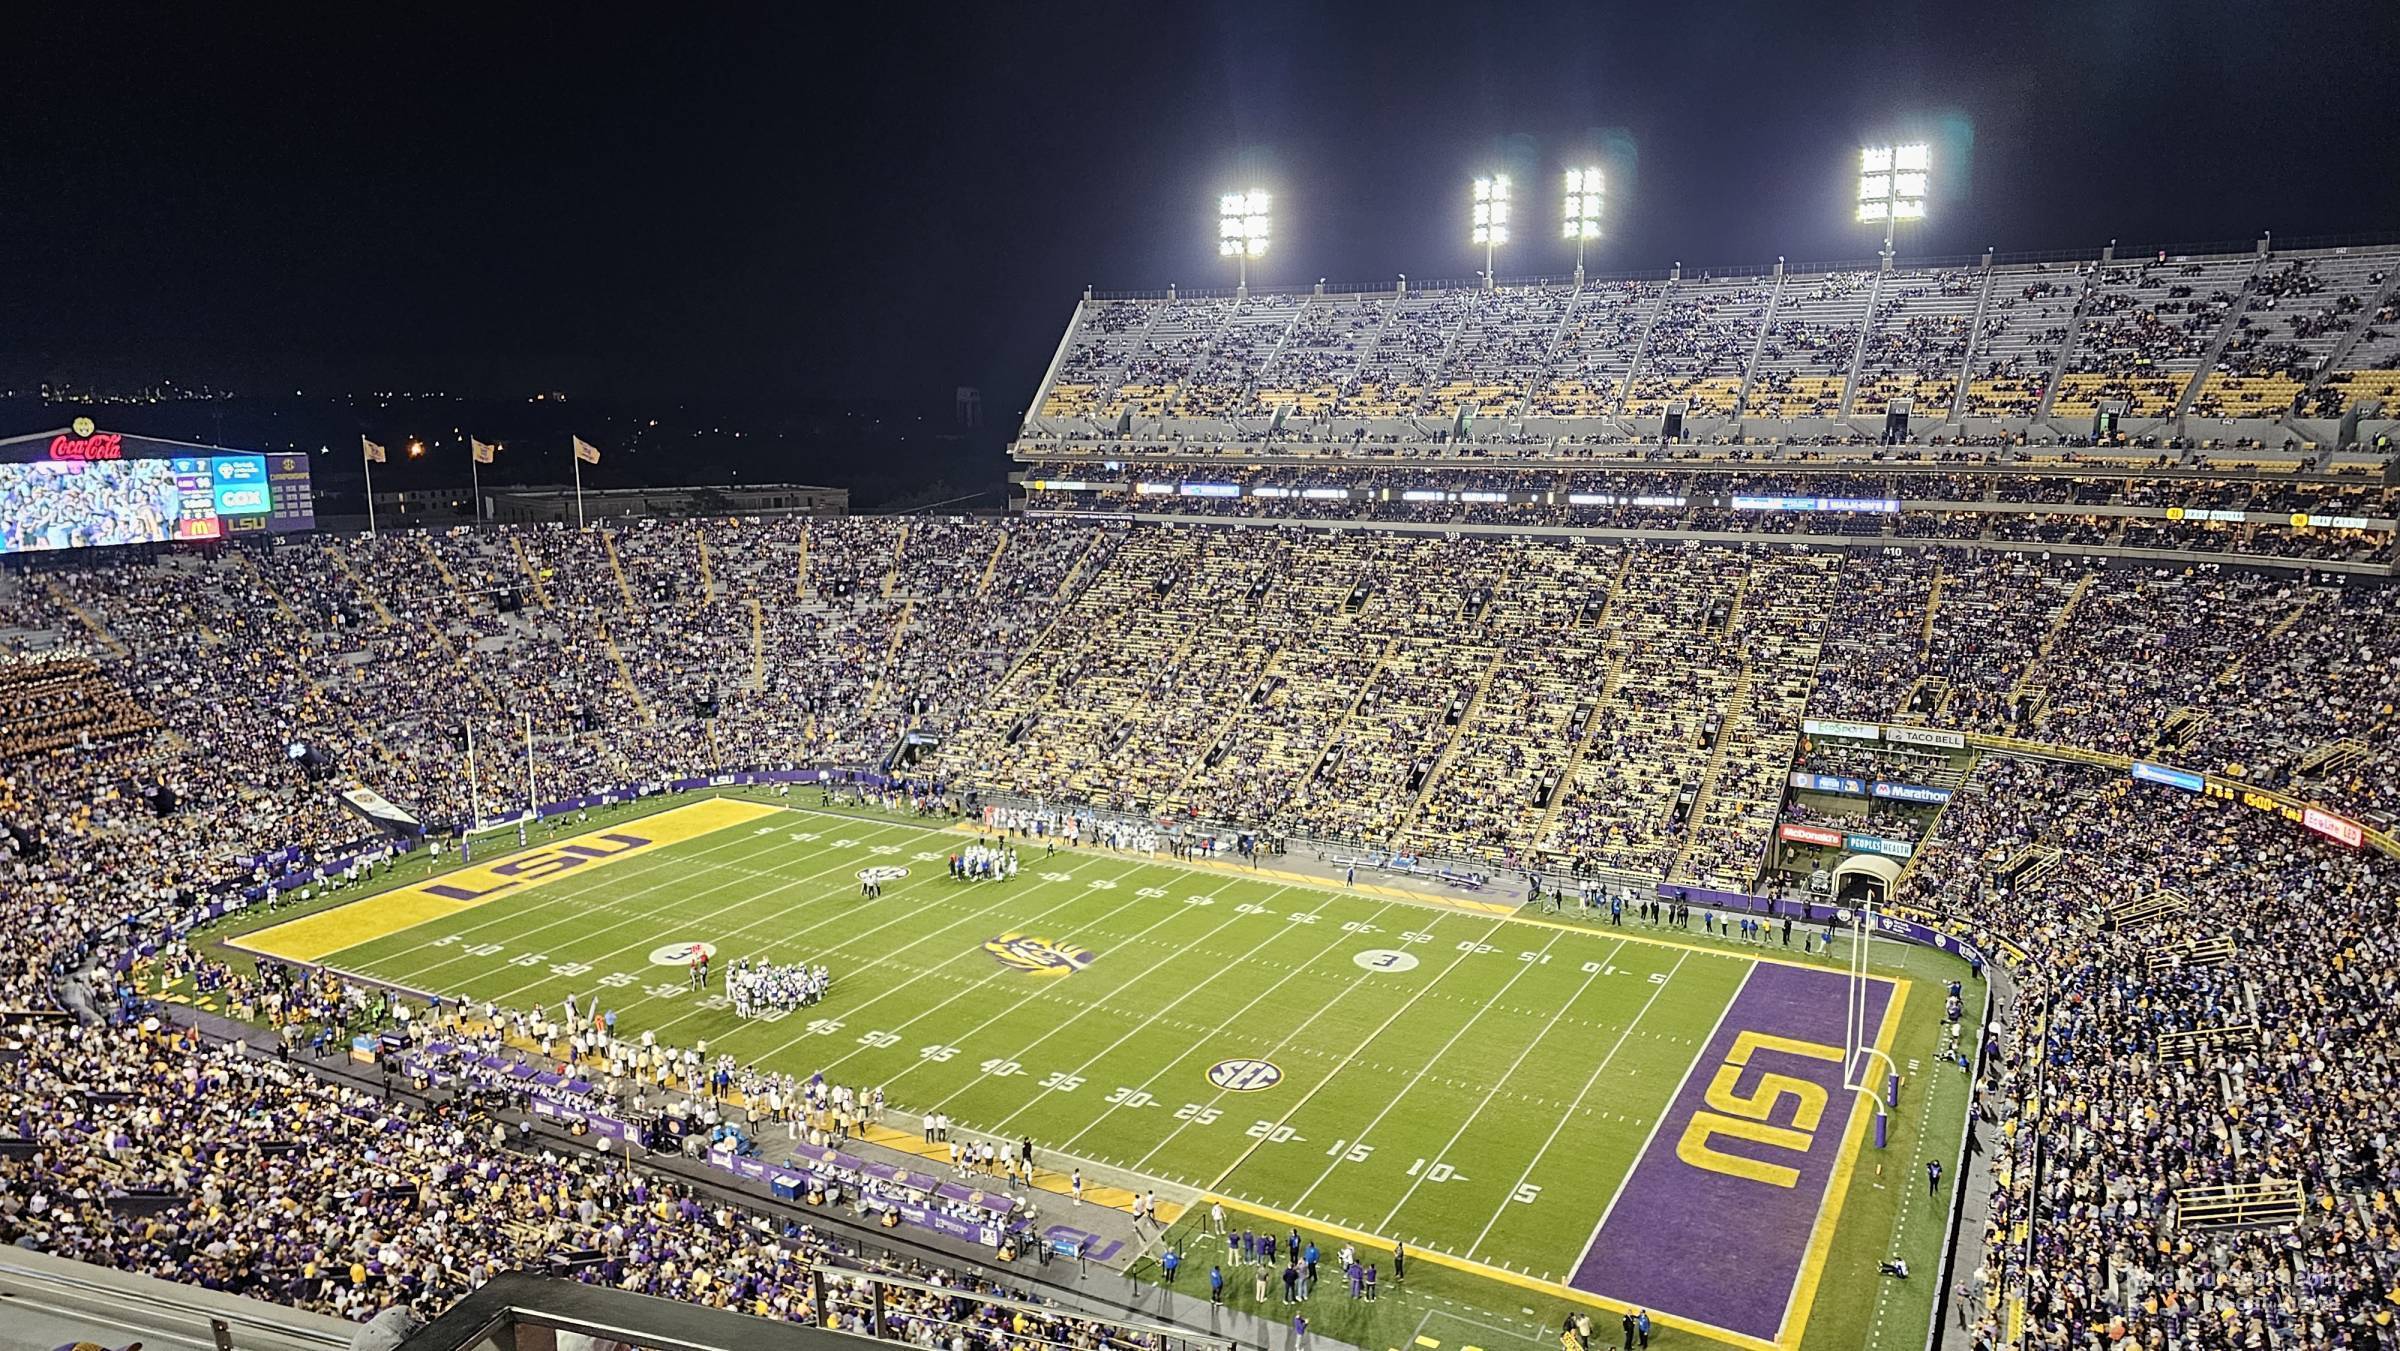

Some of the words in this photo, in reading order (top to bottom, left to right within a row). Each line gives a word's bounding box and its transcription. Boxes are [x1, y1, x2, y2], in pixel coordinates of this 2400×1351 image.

[228, 517, 266, 531] LSU
[271, 536, 286, 546] 35
[1446, 531, 1460, 539] 303
[1569, 536, 1586, 545] 304
[1683, 539, 1700, 548] 305
[1906, 732, 1933, 742] TACO
[1935, 735, 1961, 745] BELL
[709, 774, 735, 786] LSU
[1892, 786, 1949, 804] Marathon
[1850, 837, 1880, 851] PEOPLES
[1883, 842, 1910, 855] HEALTH
[421, 833, 653, 902] LSU
[550, 962, 593, 977] 20
[596, 972, 640, 987] 25
[648, 983, 690, 999] 30
[806, 1018, 846, 1036] 45
[857, 1030, 902, 1049] 50
[919, 1044, 961, 1063] 45
[980, 1058, 1023, 1077] 40
[1210, 1060, 1281, 1091] SEC
[1038, 1072, 1087, 1092] 35
[1104, 1087, 1154, 1109] 30
[1172, 1103, 1224, 1126] 25
[1676, 1030, 1847, 1189] LSU
[1245, 1120, 1298, 1143] 20
[1325, 1139, 1377, 1164] 15
[1405, 1158, 1457, 1184] 10
[1512, 1182, 1543, 1205] 5
